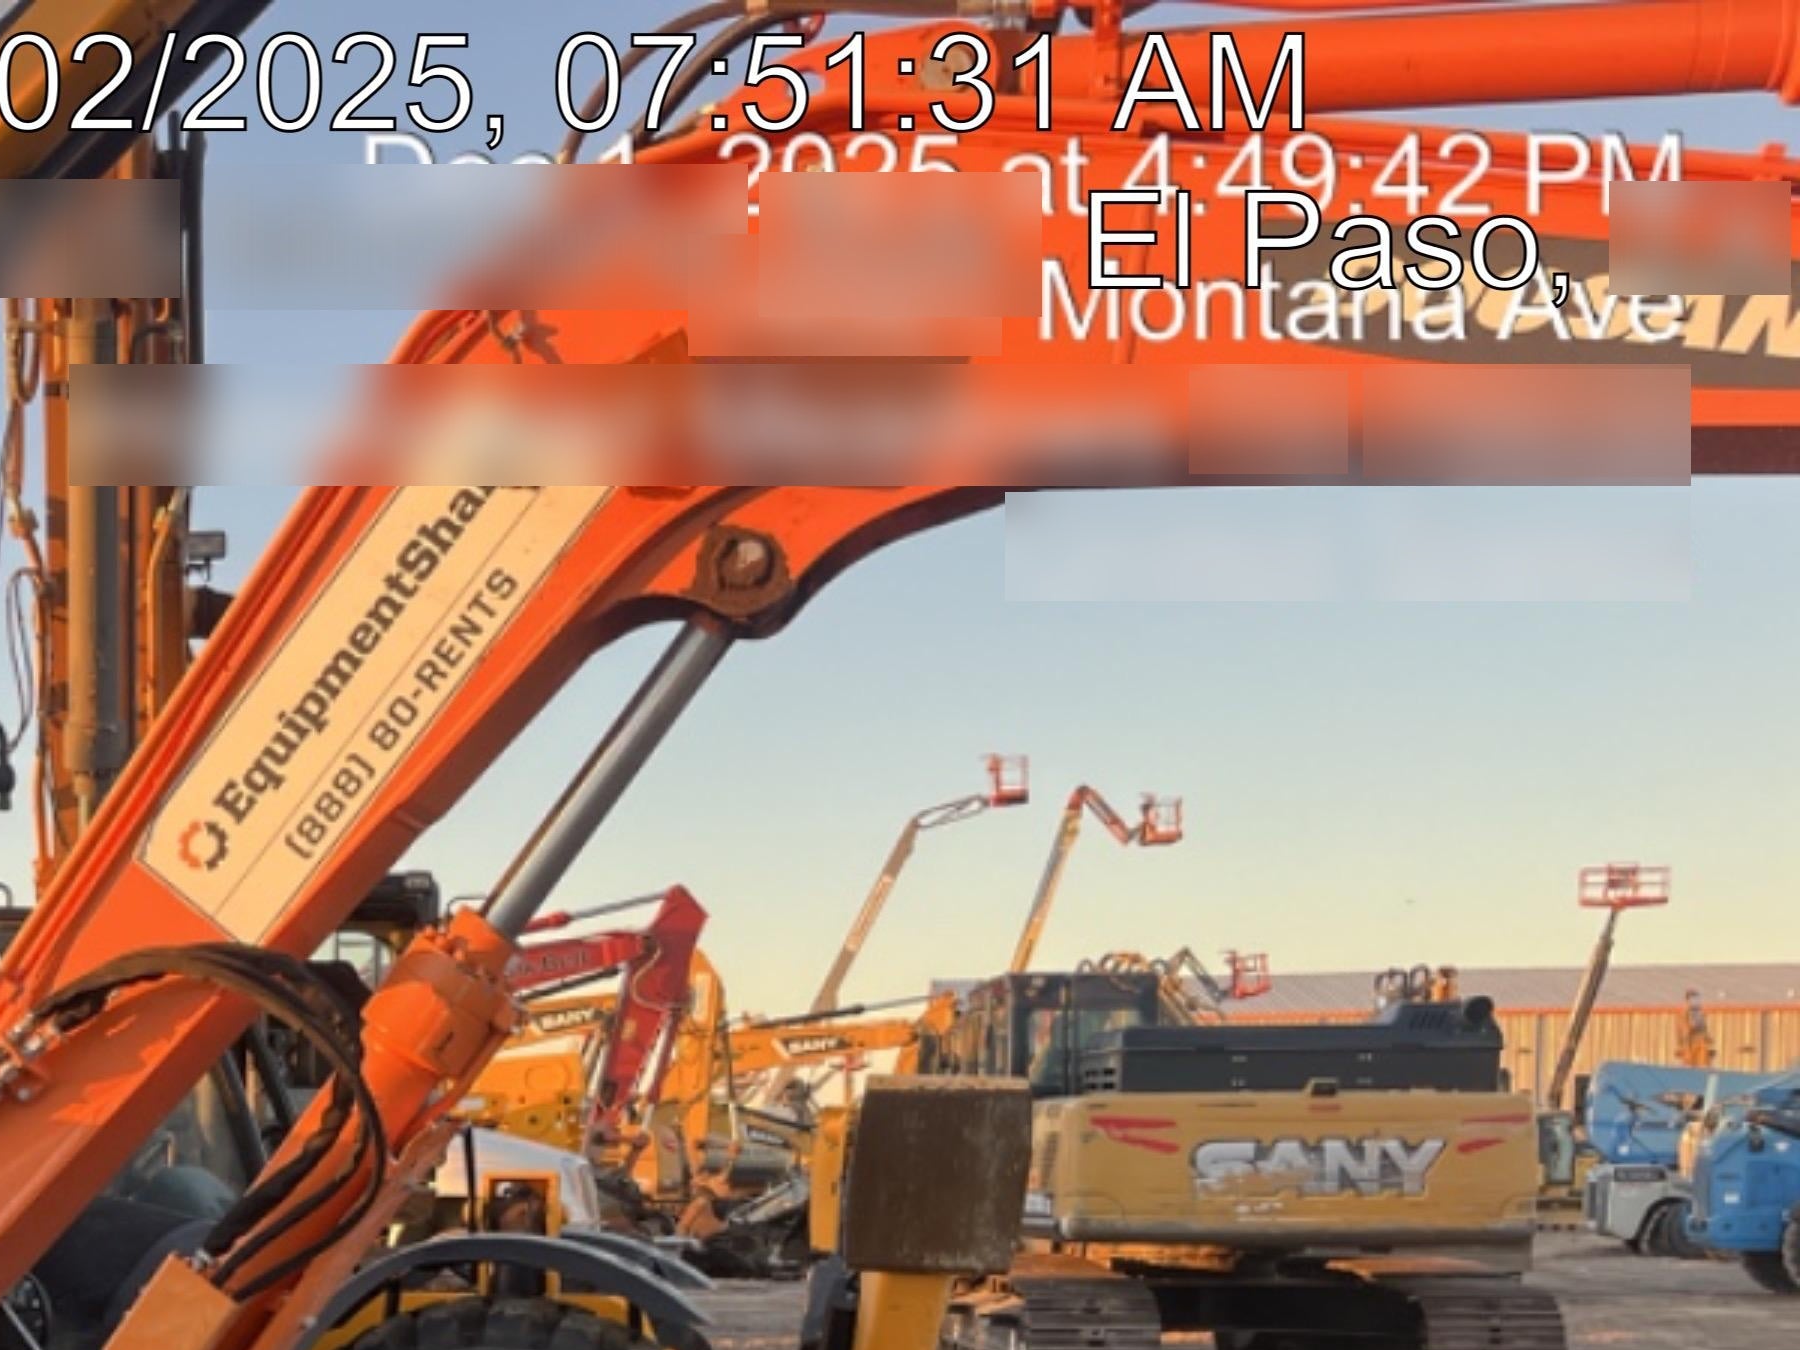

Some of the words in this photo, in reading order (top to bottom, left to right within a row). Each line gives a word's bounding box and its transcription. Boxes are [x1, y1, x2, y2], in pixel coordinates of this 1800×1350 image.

[213, 486, 540, 826] EquipmentSha
[283, 752, 377, 860] (888)
[367, 565, 520, 755] 80-RENTS
[1192, 1136, 1447, 1197] SANY
